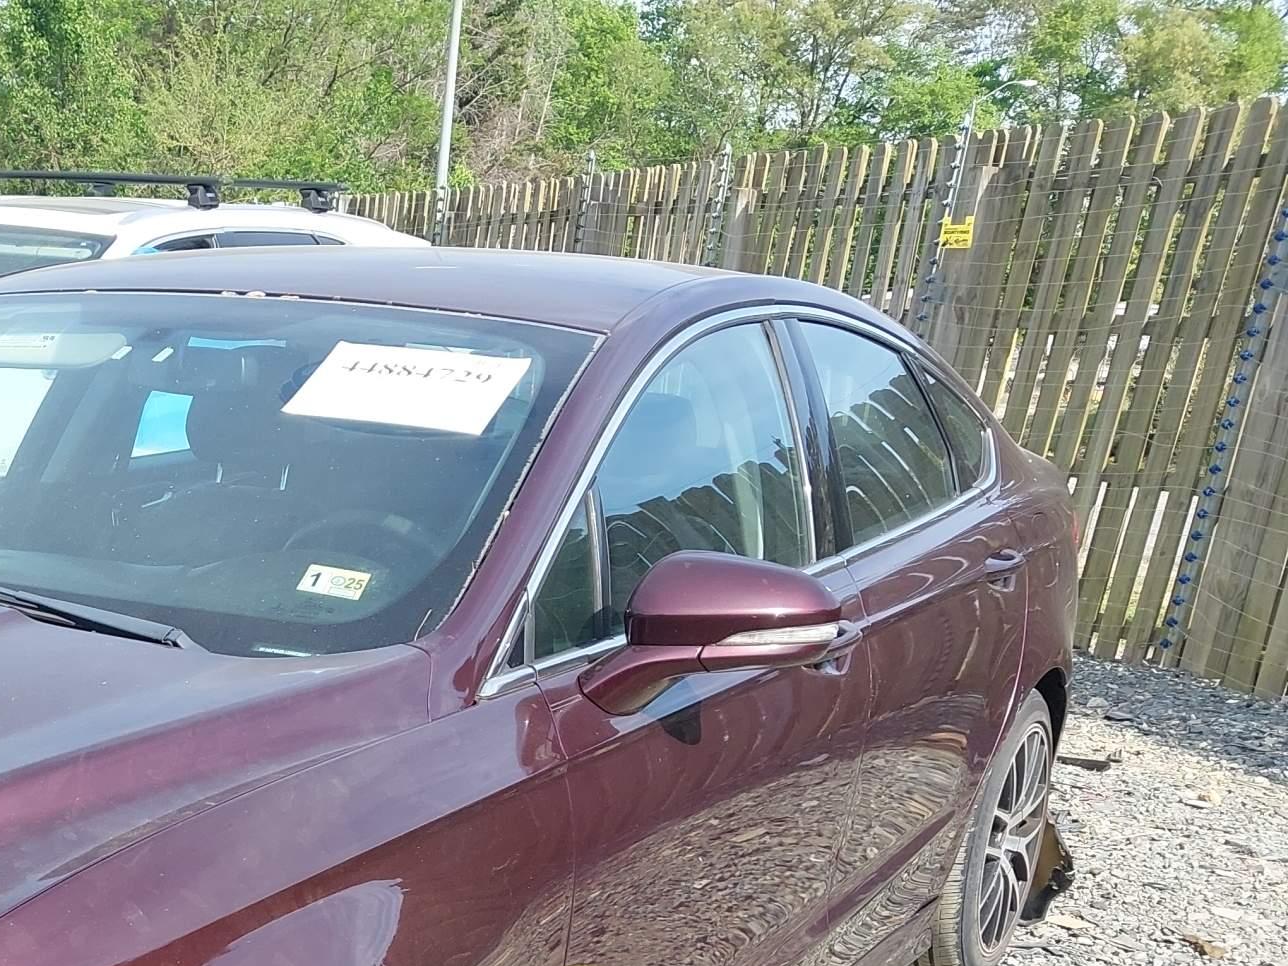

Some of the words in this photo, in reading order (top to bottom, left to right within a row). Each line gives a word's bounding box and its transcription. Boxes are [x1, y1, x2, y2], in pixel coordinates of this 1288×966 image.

[341, 360, 493, 384] 44884729
[310, 572, 322, 588] 1
[343, 577, 366, 591] 25
